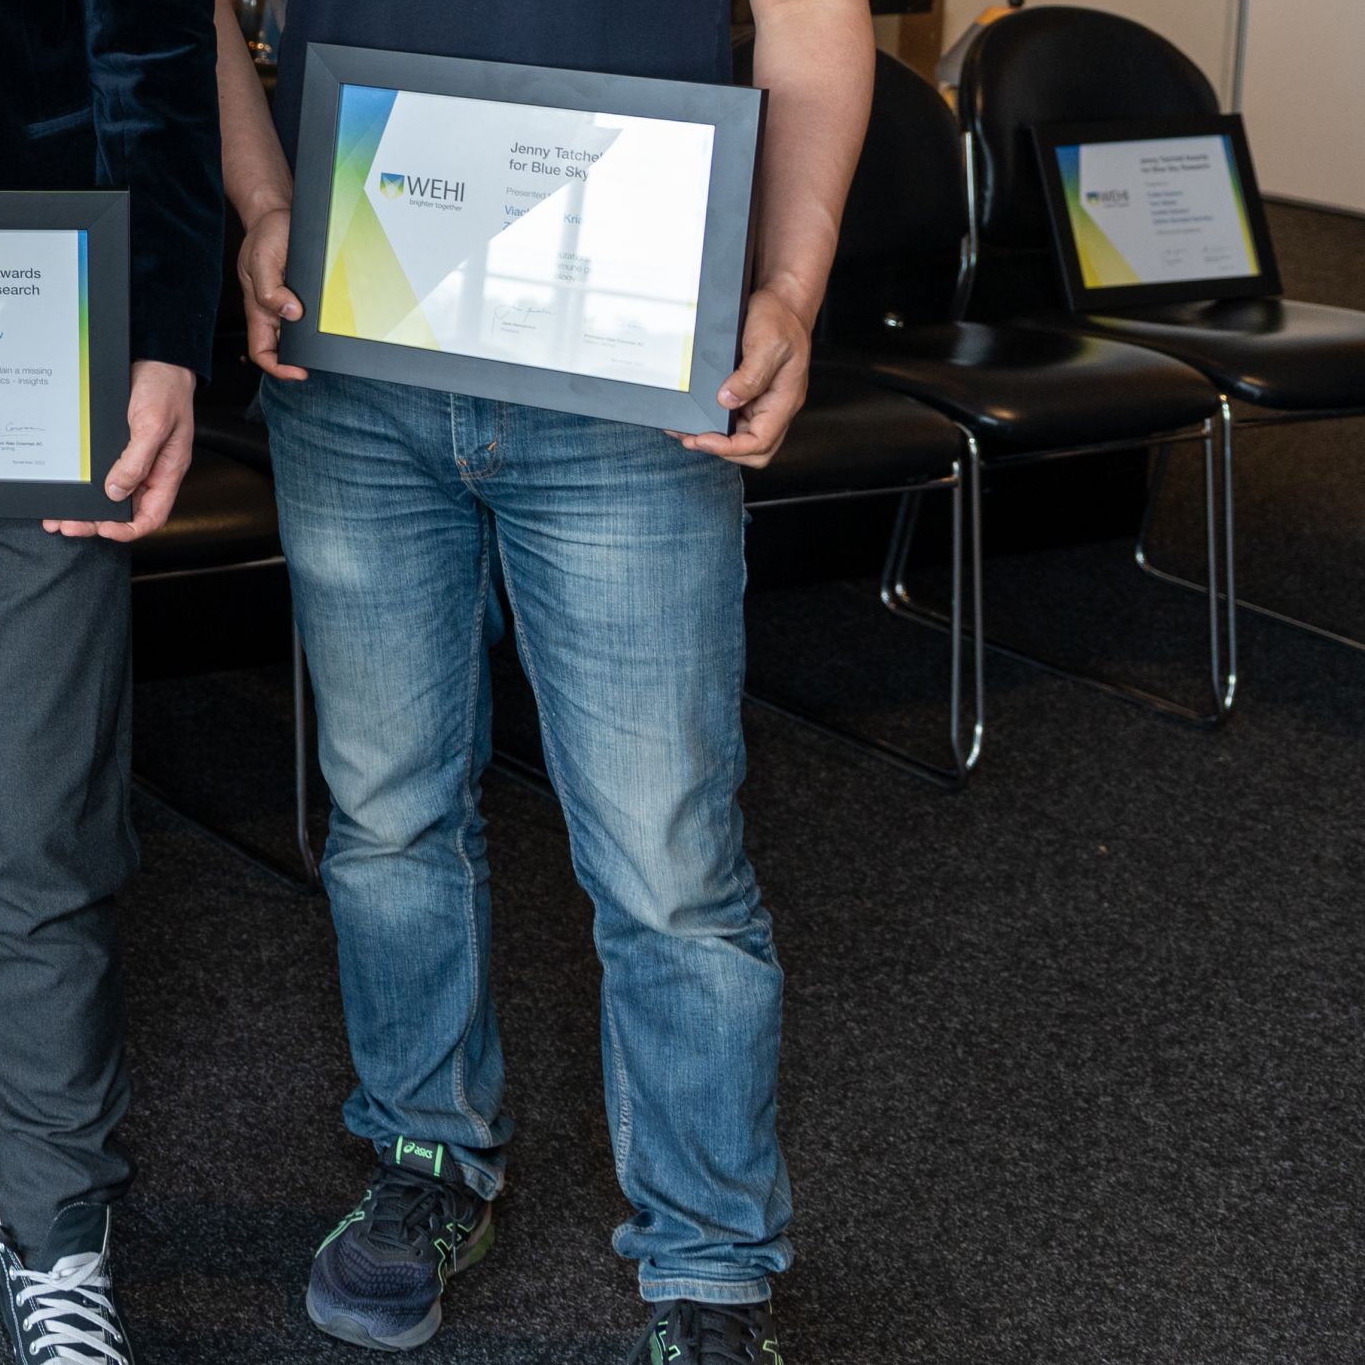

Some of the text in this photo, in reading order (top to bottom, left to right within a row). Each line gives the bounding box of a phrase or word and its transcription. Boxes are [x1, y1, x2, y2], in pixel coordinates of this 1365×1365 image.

[510, 142, 550, 159] Jenny
[509, 159, 589, 182] for Blue Sky
[407, 175, 465, 203] WEHI
[506, 186, 546, 200] Presented
[409, 198, 462, 212] brighter together
[22, 367, 53, 377] missing
[18, 377, 49, 386] insights
